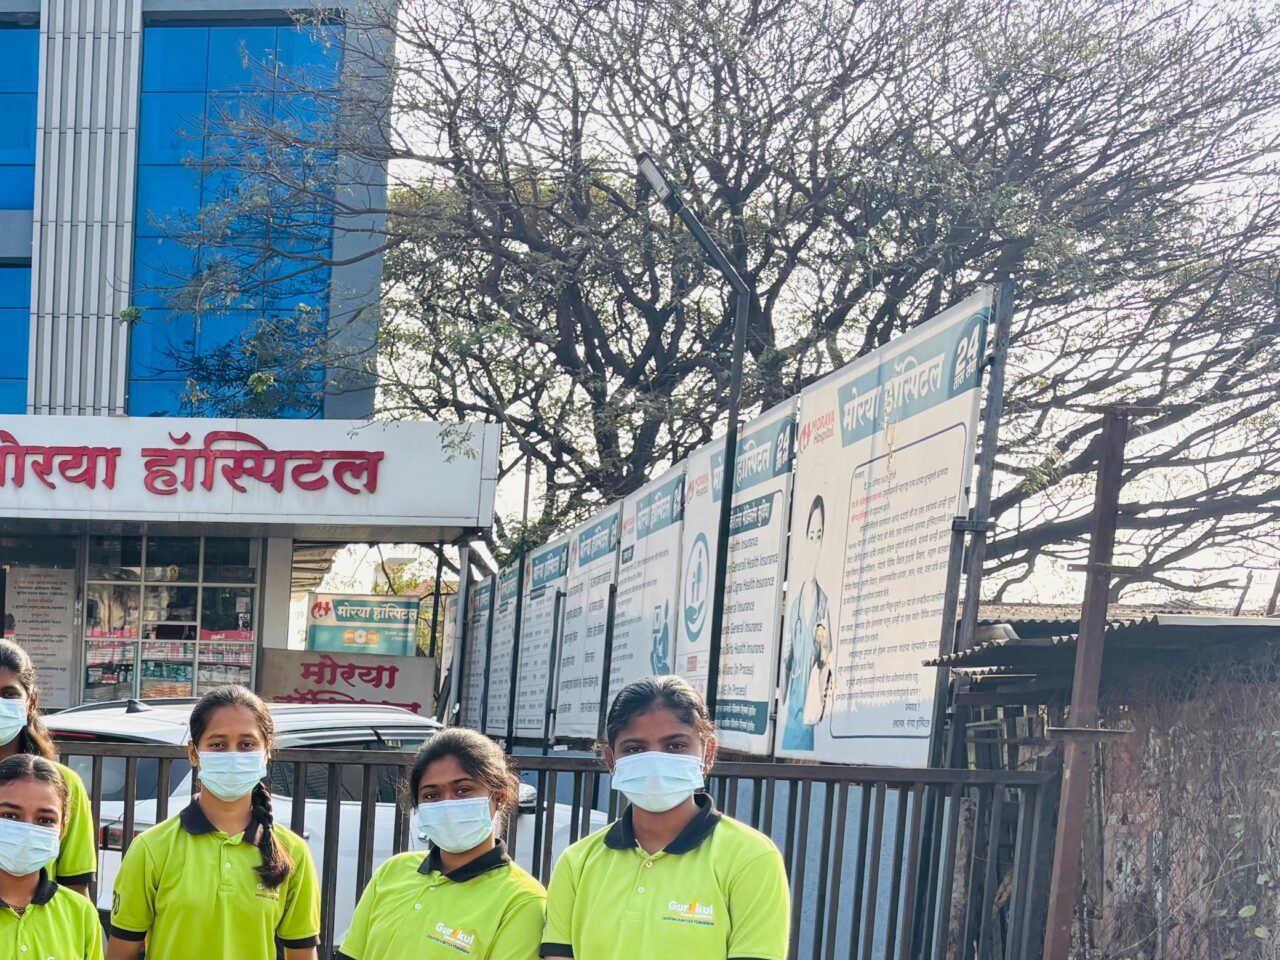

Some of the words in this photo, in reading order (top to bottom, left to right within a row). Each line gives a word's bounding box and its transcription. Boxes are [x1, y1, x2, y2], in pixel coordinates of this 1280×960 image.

[955, 324, 980, 376] 24
[811, 411, 835, 433] MORAYA
[843, 386, 882, 433] मोरया
[777, 423, 791, 454] 24
[813, 427, 834, 446] Hospital
[141, 431, 384, 495] हॉस्पिटल
[736, 438, 772, 487] हॉस्पिटल
[337, 601, 371, 619] मोरया
[372, 602, 418, 622] हॉस्पिटल
[301, 654, 400, 689] मोरया
